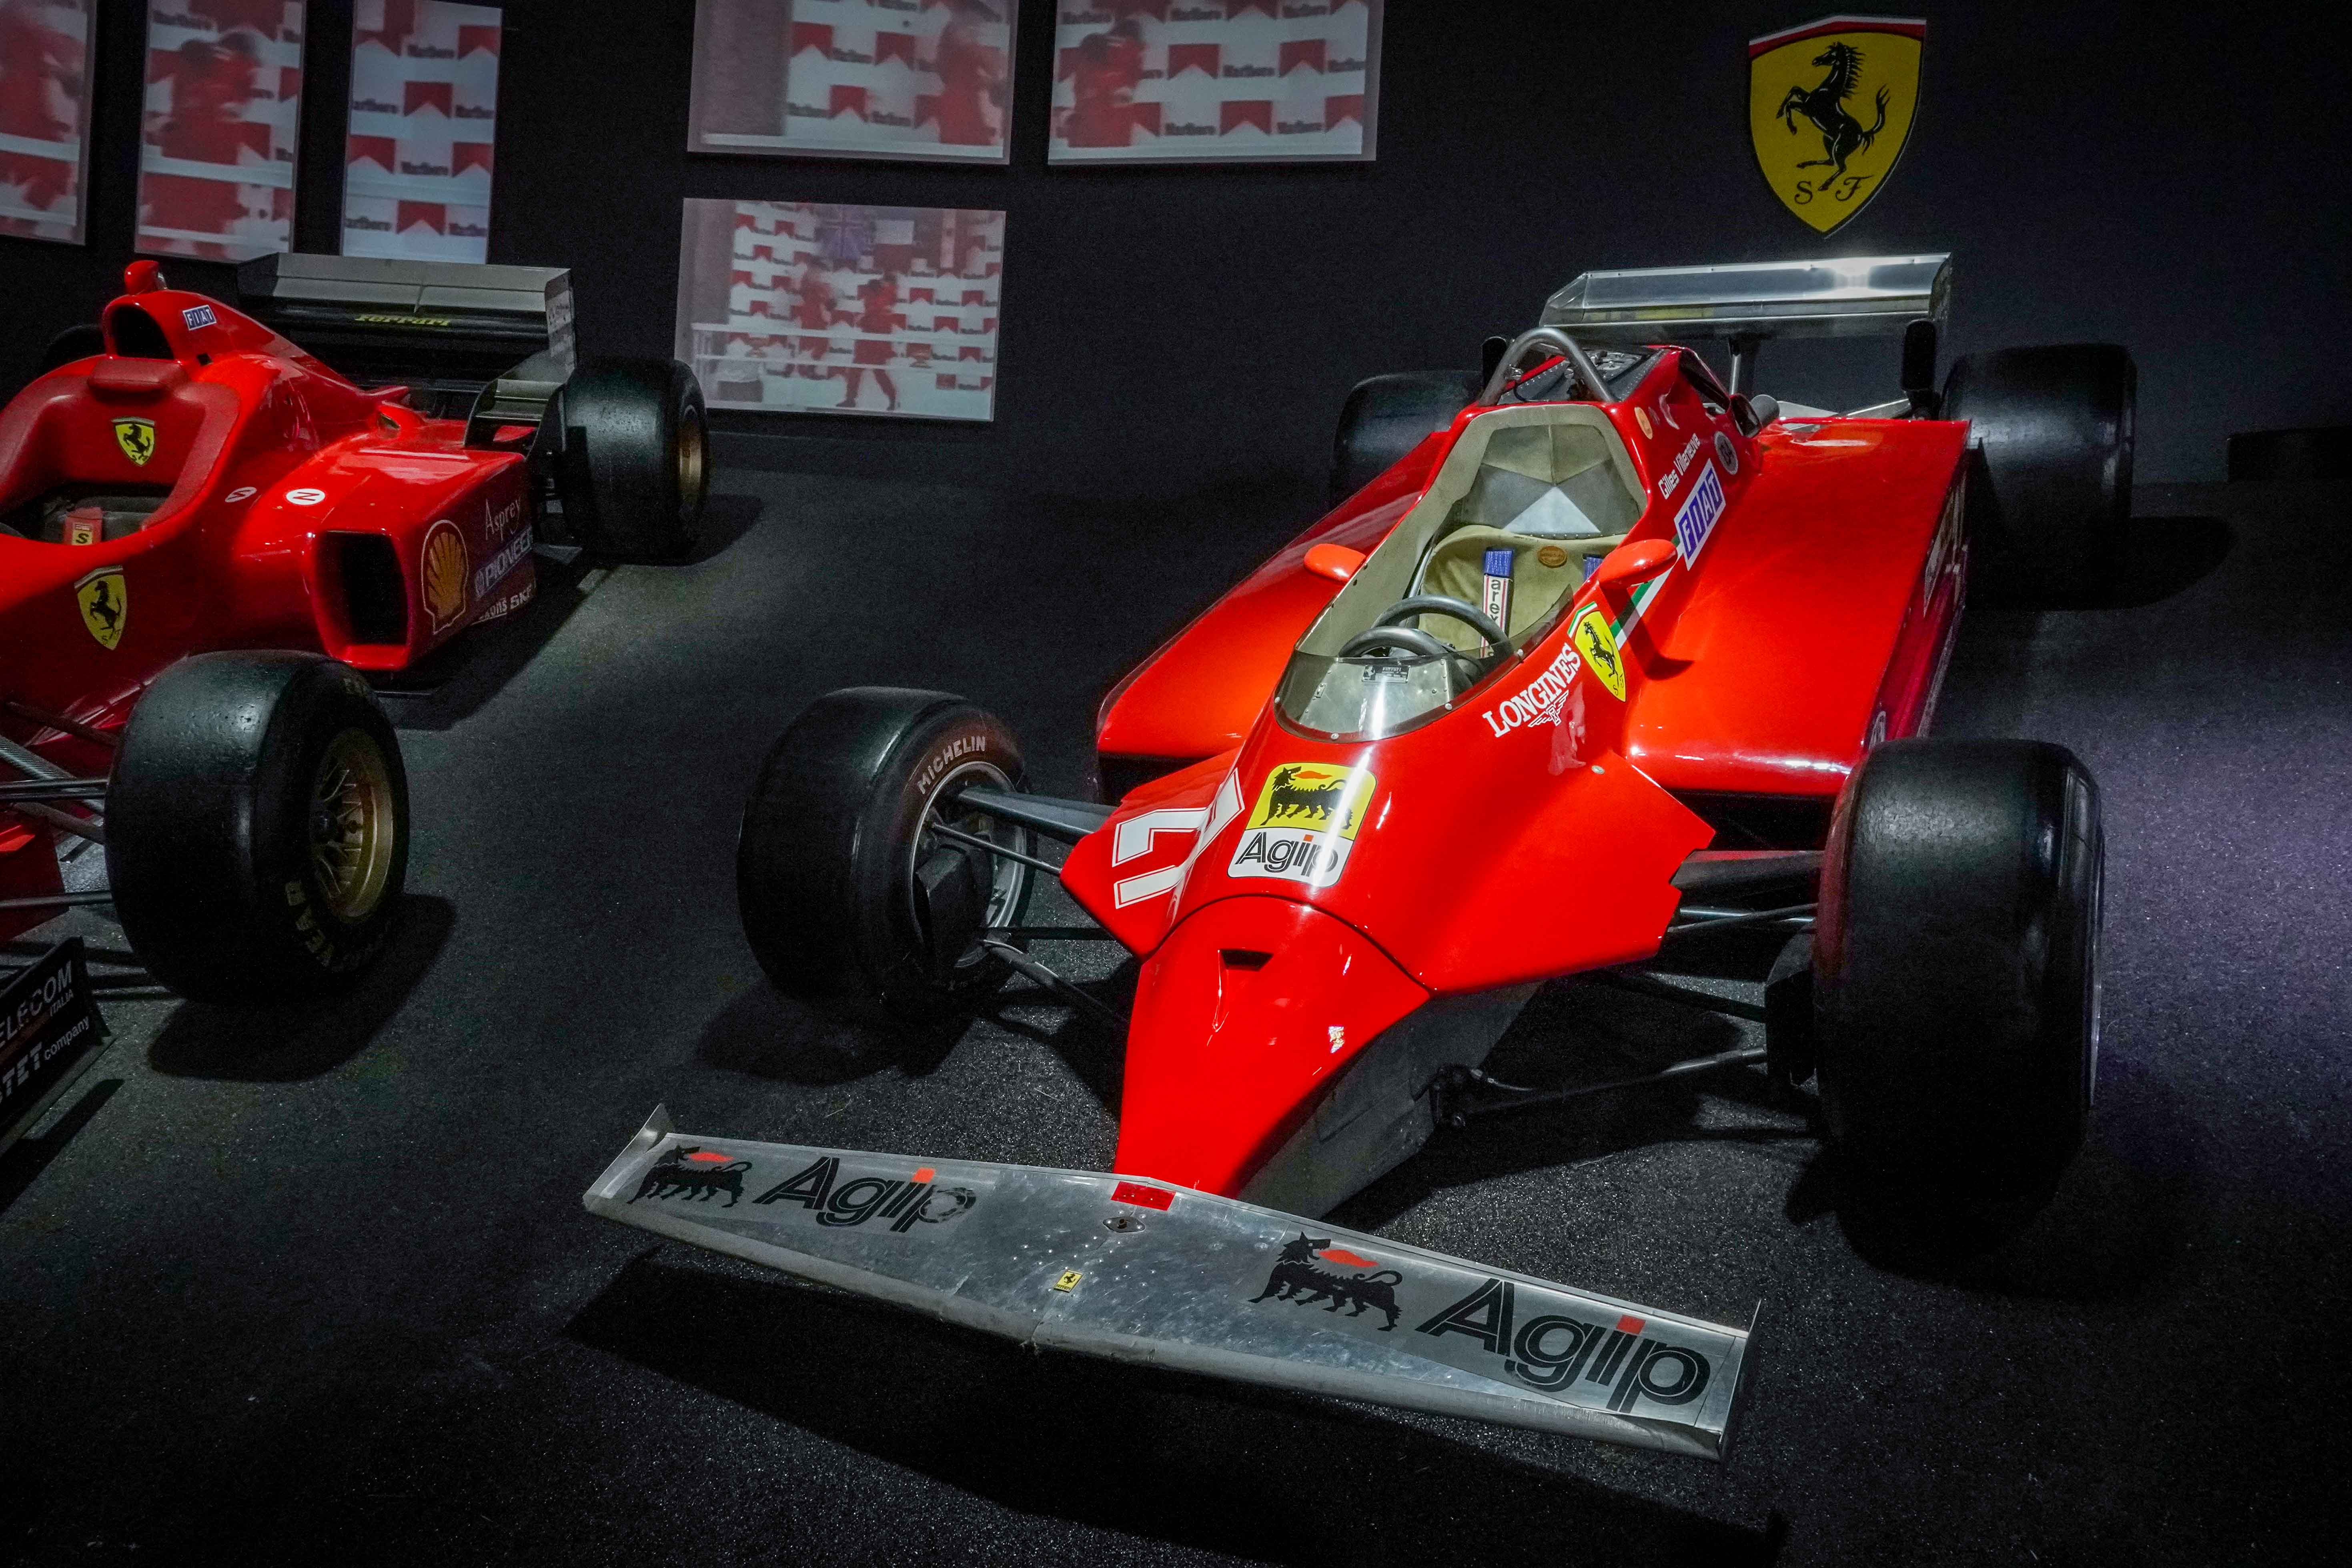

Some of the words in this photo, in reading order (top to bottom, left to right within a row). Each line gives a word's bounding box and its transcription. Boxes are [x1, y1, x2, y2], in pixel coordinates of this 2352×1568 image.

[186, 308, 213, 326] FIAT
[1658, 469, 1680, 500] Gilles
[1673, 433, 1701, 476] Villeneuve
[485, 495, 522, 541] Asprey
[1678, 468, 1725, 561] FIAT
[1482, 643, 1581, 738] LONGINES
[917, 735, 986, 795] MICHELIN
[1235, 832, 1338, 877] Agip
[44, 1015, 91, 1060] company
[752, 1156, 976, 1233] Agip
[1415, 1278, 1711, 1413] Agip
